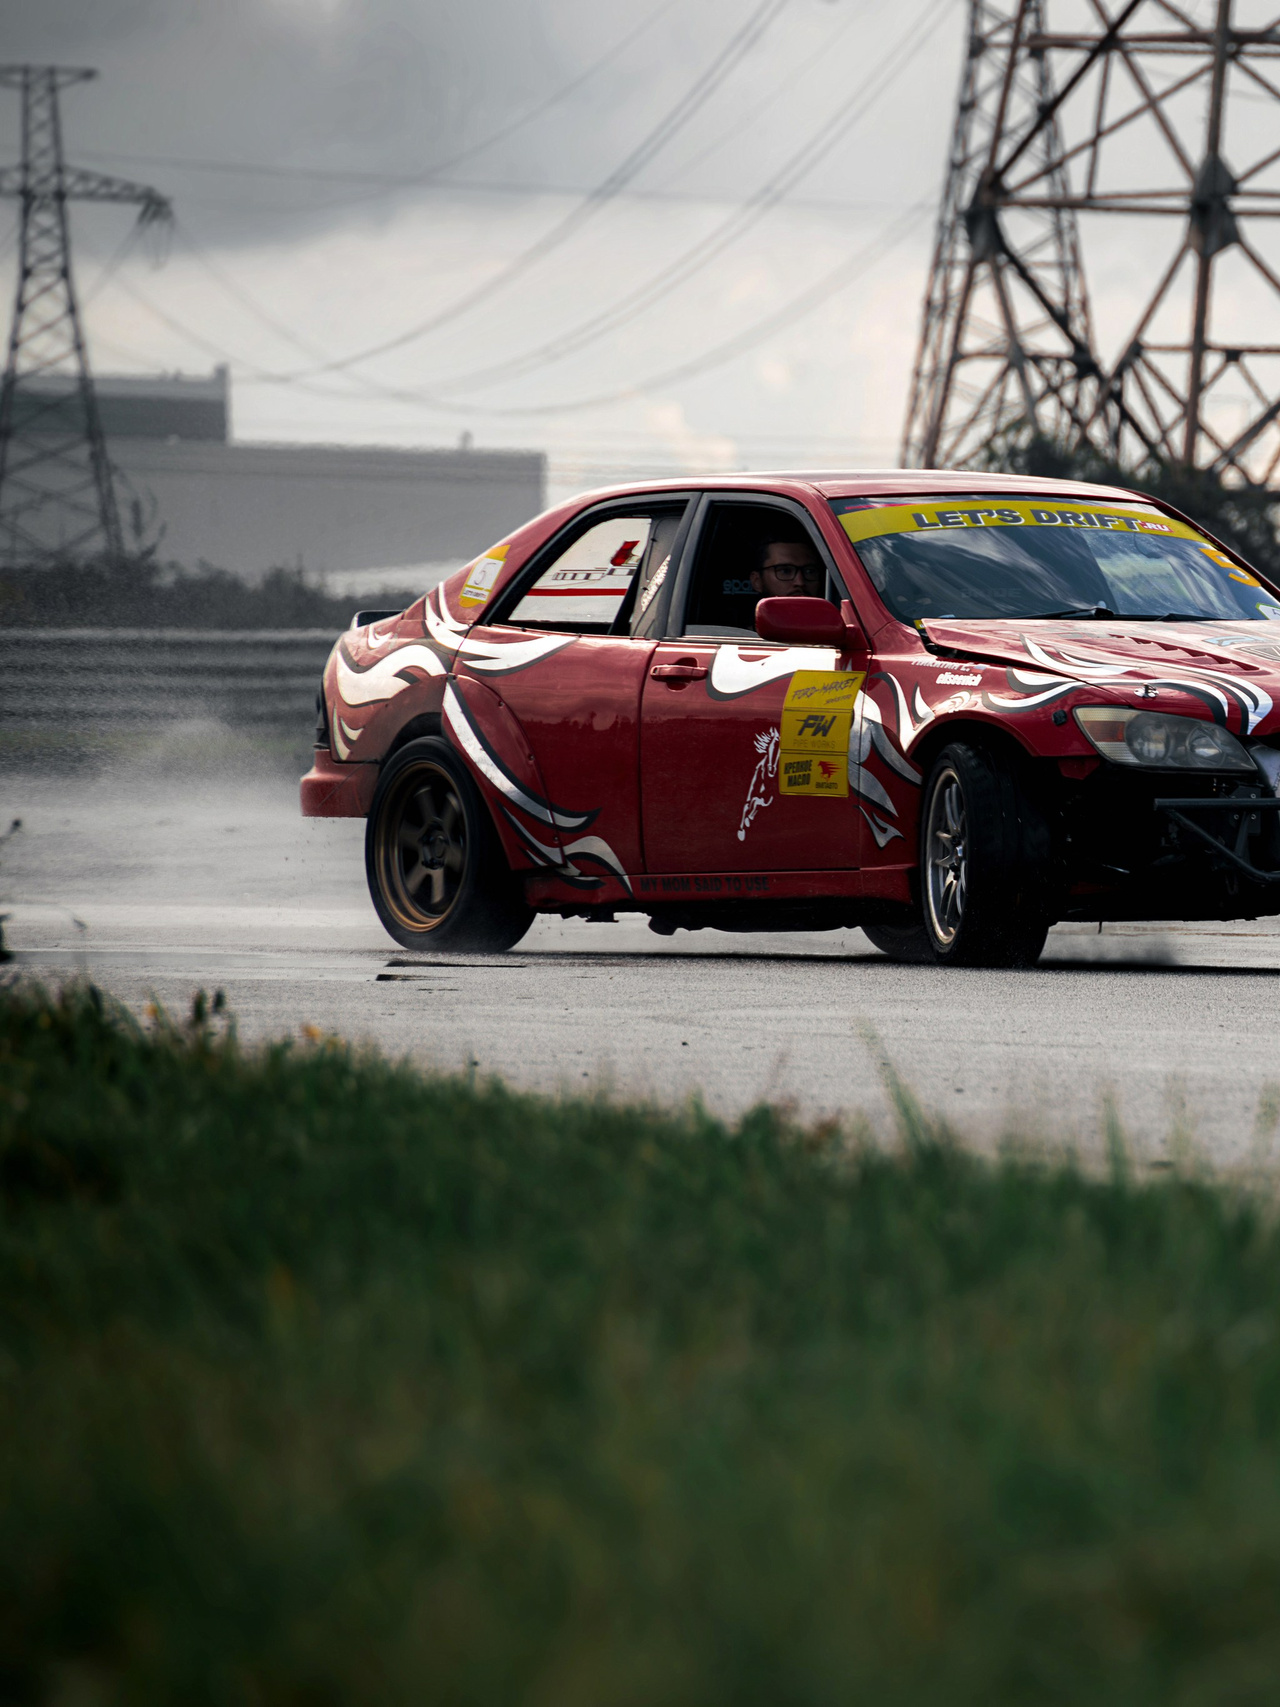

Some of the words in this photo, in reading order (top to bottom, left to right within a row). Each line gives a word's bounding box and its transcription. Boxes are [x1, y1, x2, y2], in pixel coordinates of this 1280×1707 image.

[912, 508, 1025, 529] LET'S
[1198, 548, 1262, 587] 5
[793, 738, 808, 748] PIPE
[811, 739, 836, 749] WORKS
[640, 877, 658, 892] MY
[662, 877, 691, 892] MOM
[694, 877, 722, 891] SAID
[724, 877, 741, 891] TO
[745, 876, 769, 891] USE
